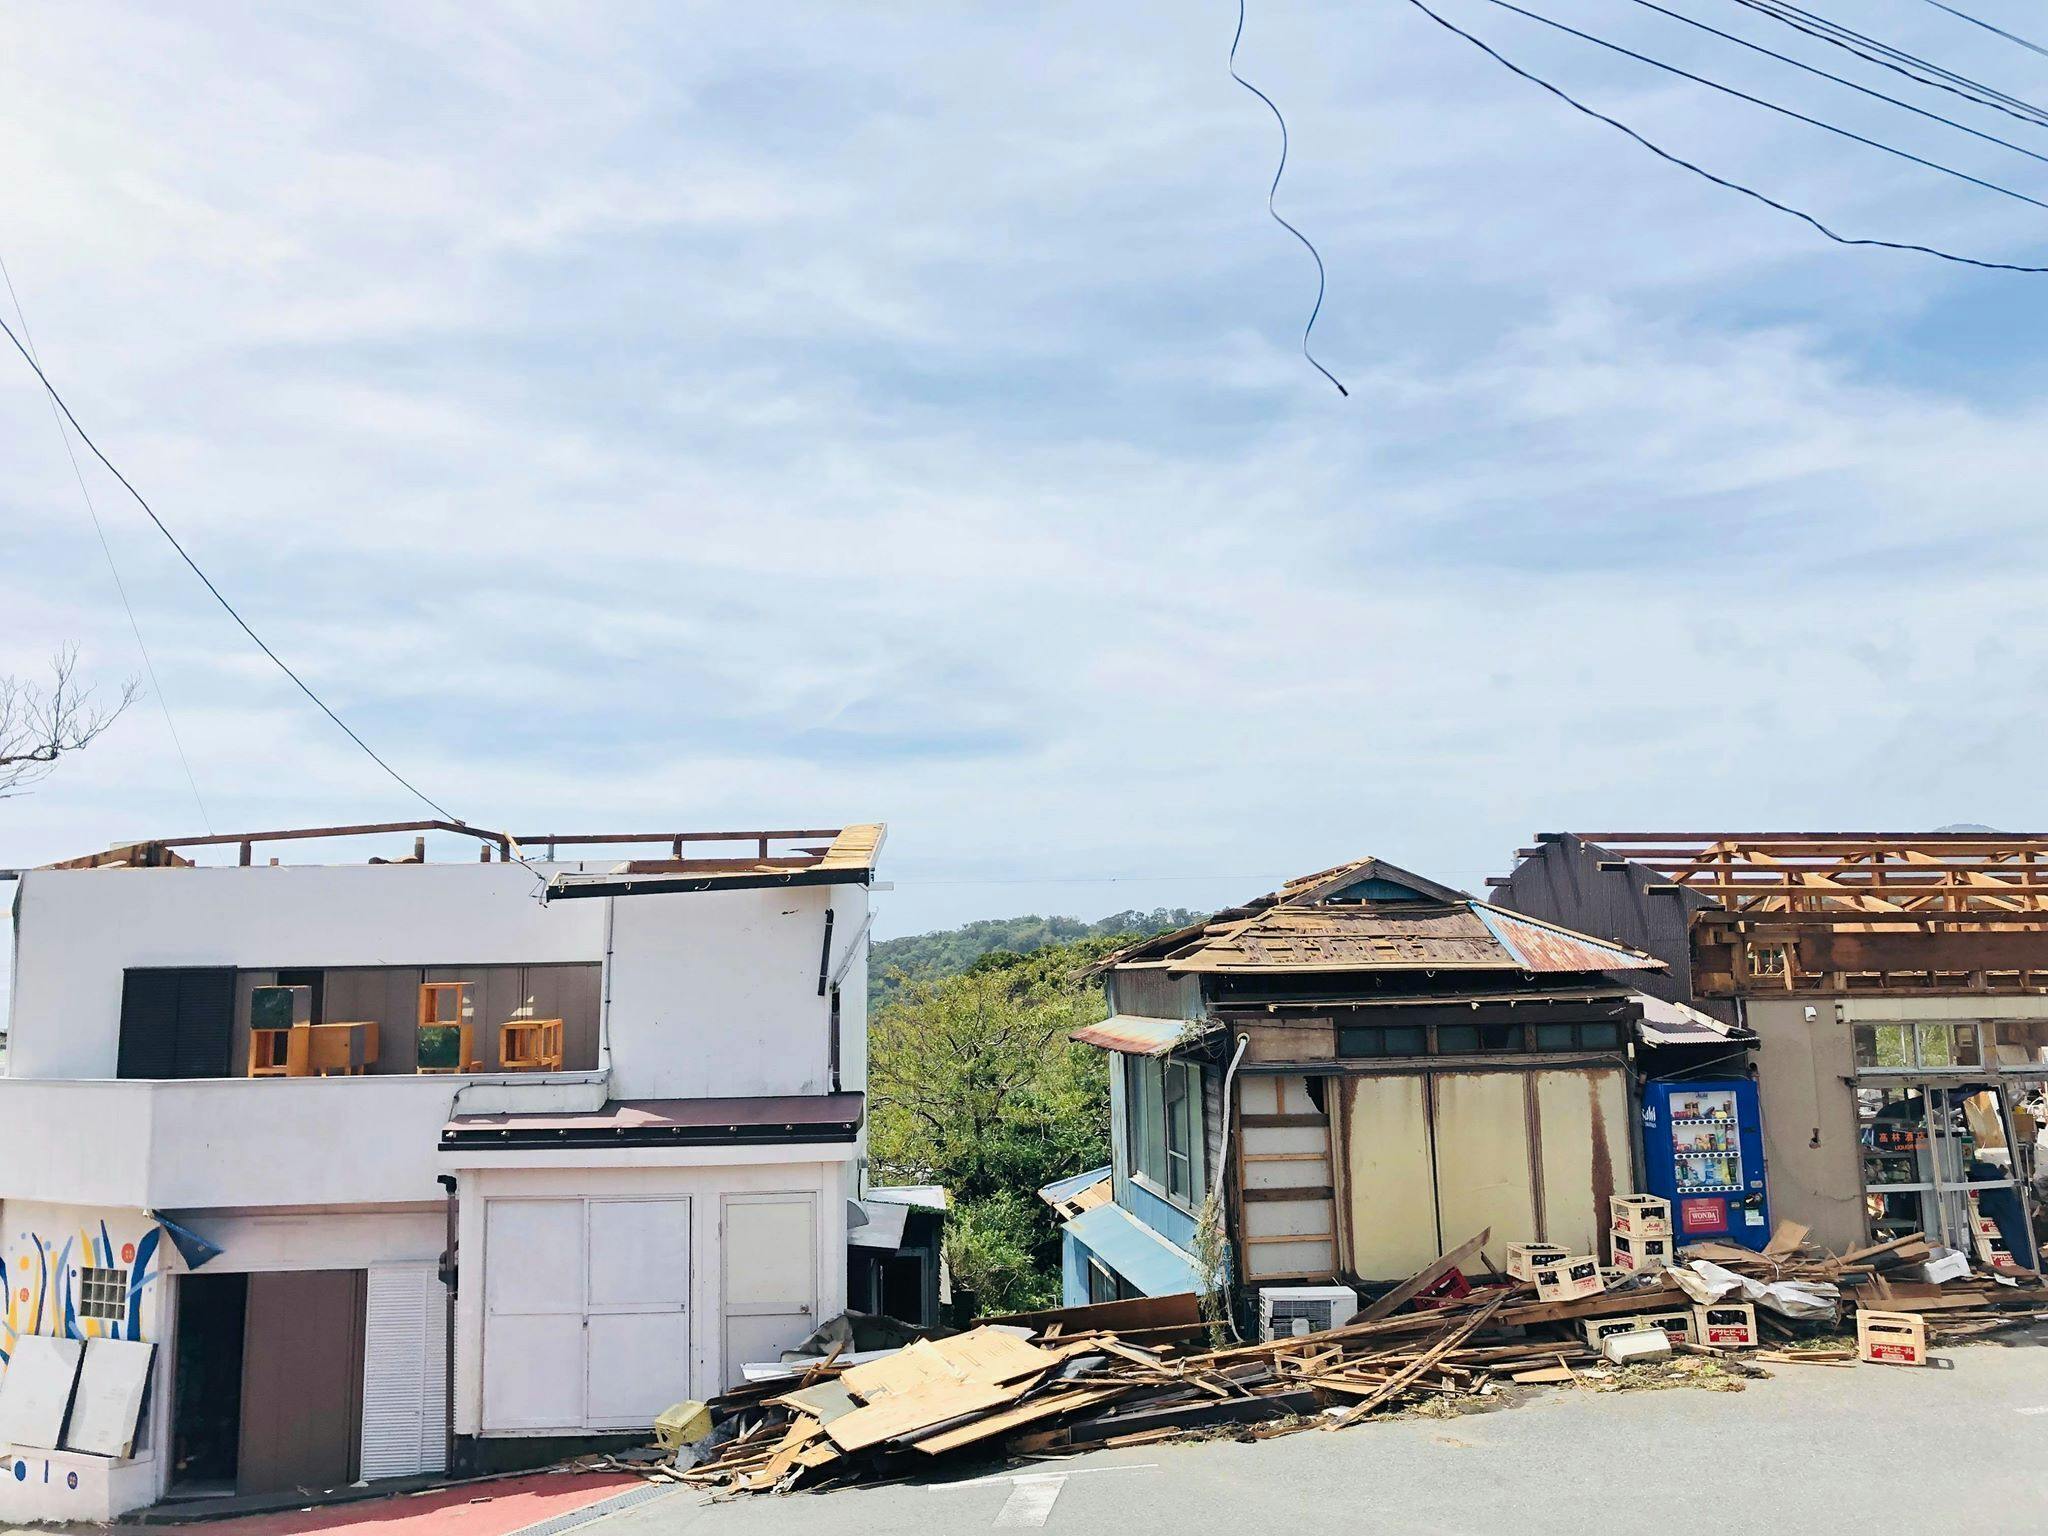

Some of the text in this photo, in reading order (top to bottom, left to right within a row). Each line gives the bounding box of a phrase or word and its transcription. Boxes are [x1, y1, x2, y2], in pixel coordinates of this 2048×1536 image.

[1691, 1211, 1716, 1220] WONDA
[1709, 1328, 1747, 1336] アサヒビール
[1871, 1344, 1914, 1354] アサヒビール
